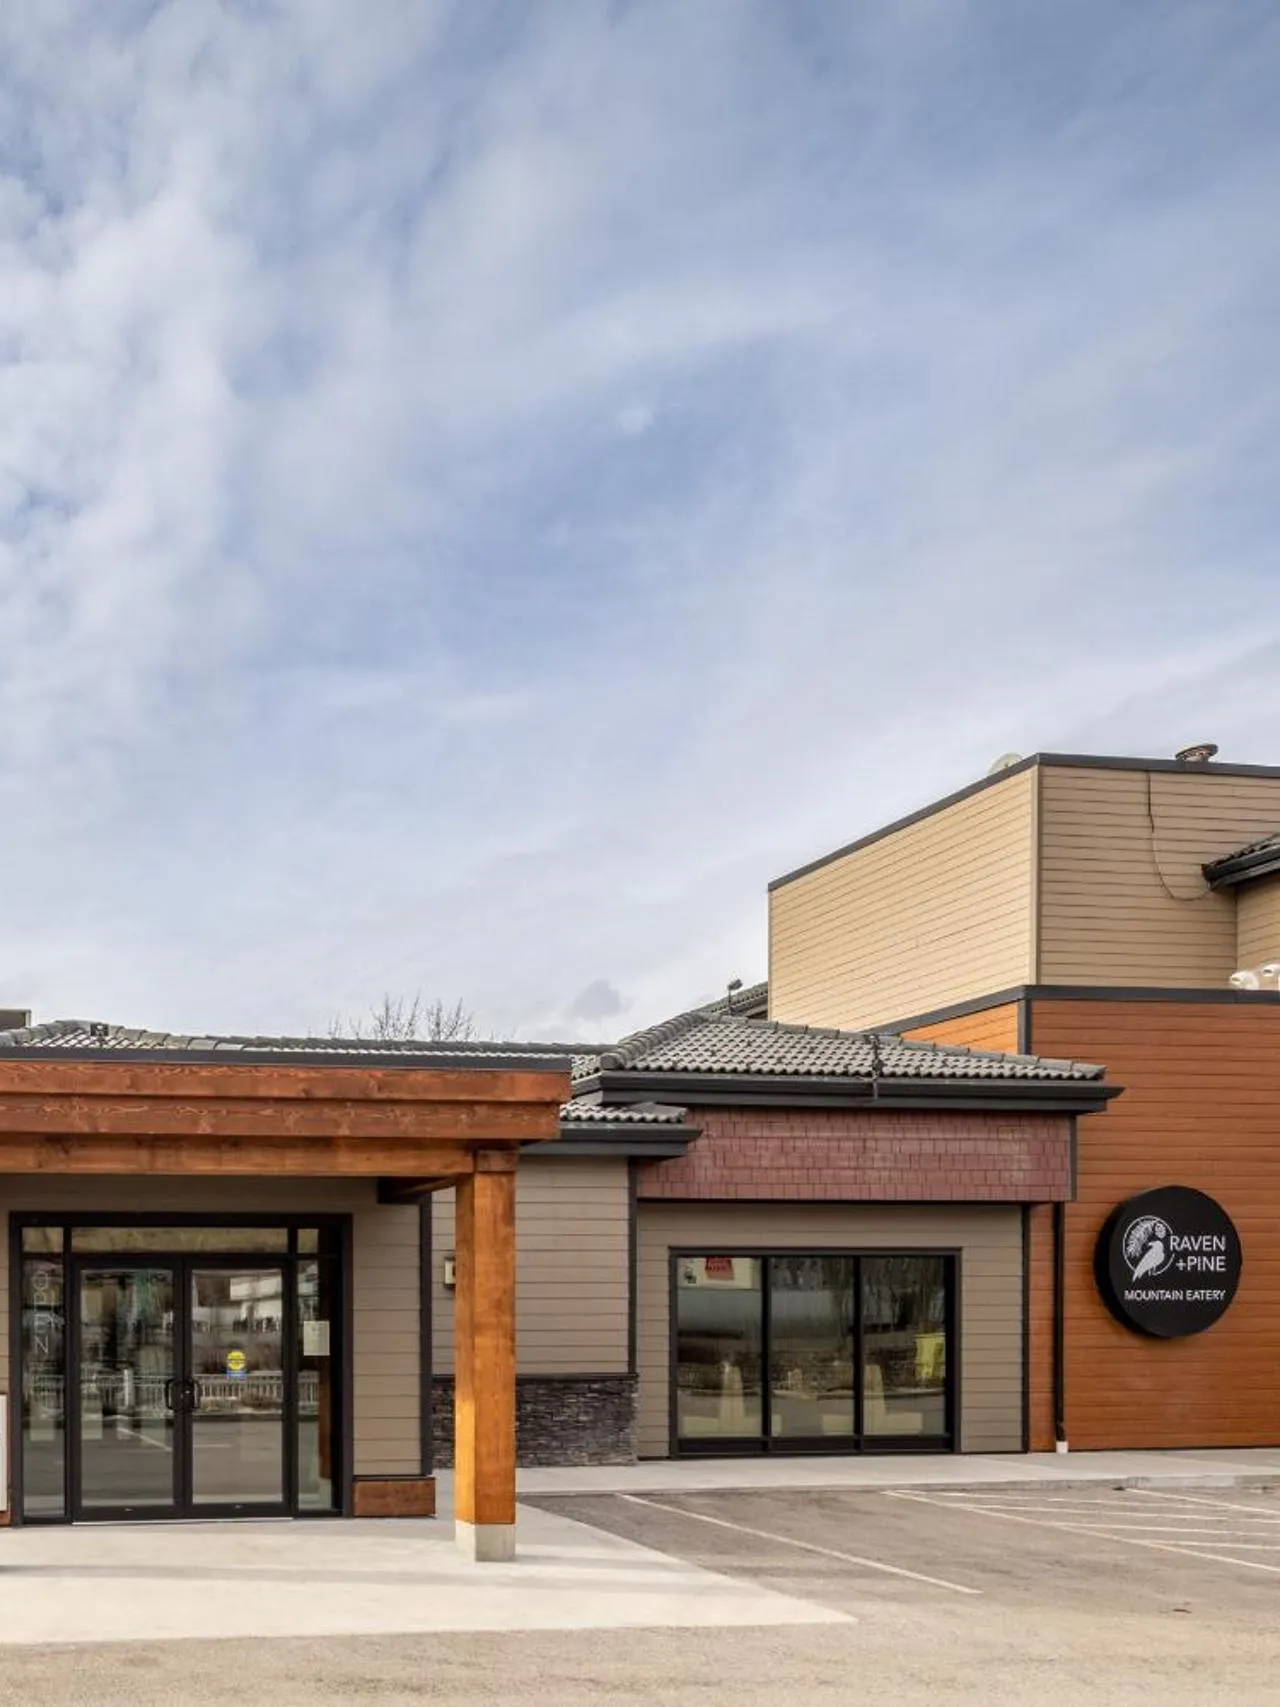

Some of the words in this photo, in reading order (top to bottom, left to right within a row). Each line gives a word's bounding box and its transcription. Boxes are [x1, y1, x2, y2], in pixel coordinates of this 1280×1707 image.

[1170, 1235, 1226, 1251] RAVEN
[1176, 1255, 1227, 1272] +PINE
[1124, 1289, 1184, 1301] MOUNTAIN
[1186, 1289, 1226, 1301] EATERY
[31, 1270, 49, 1354] OPEN
